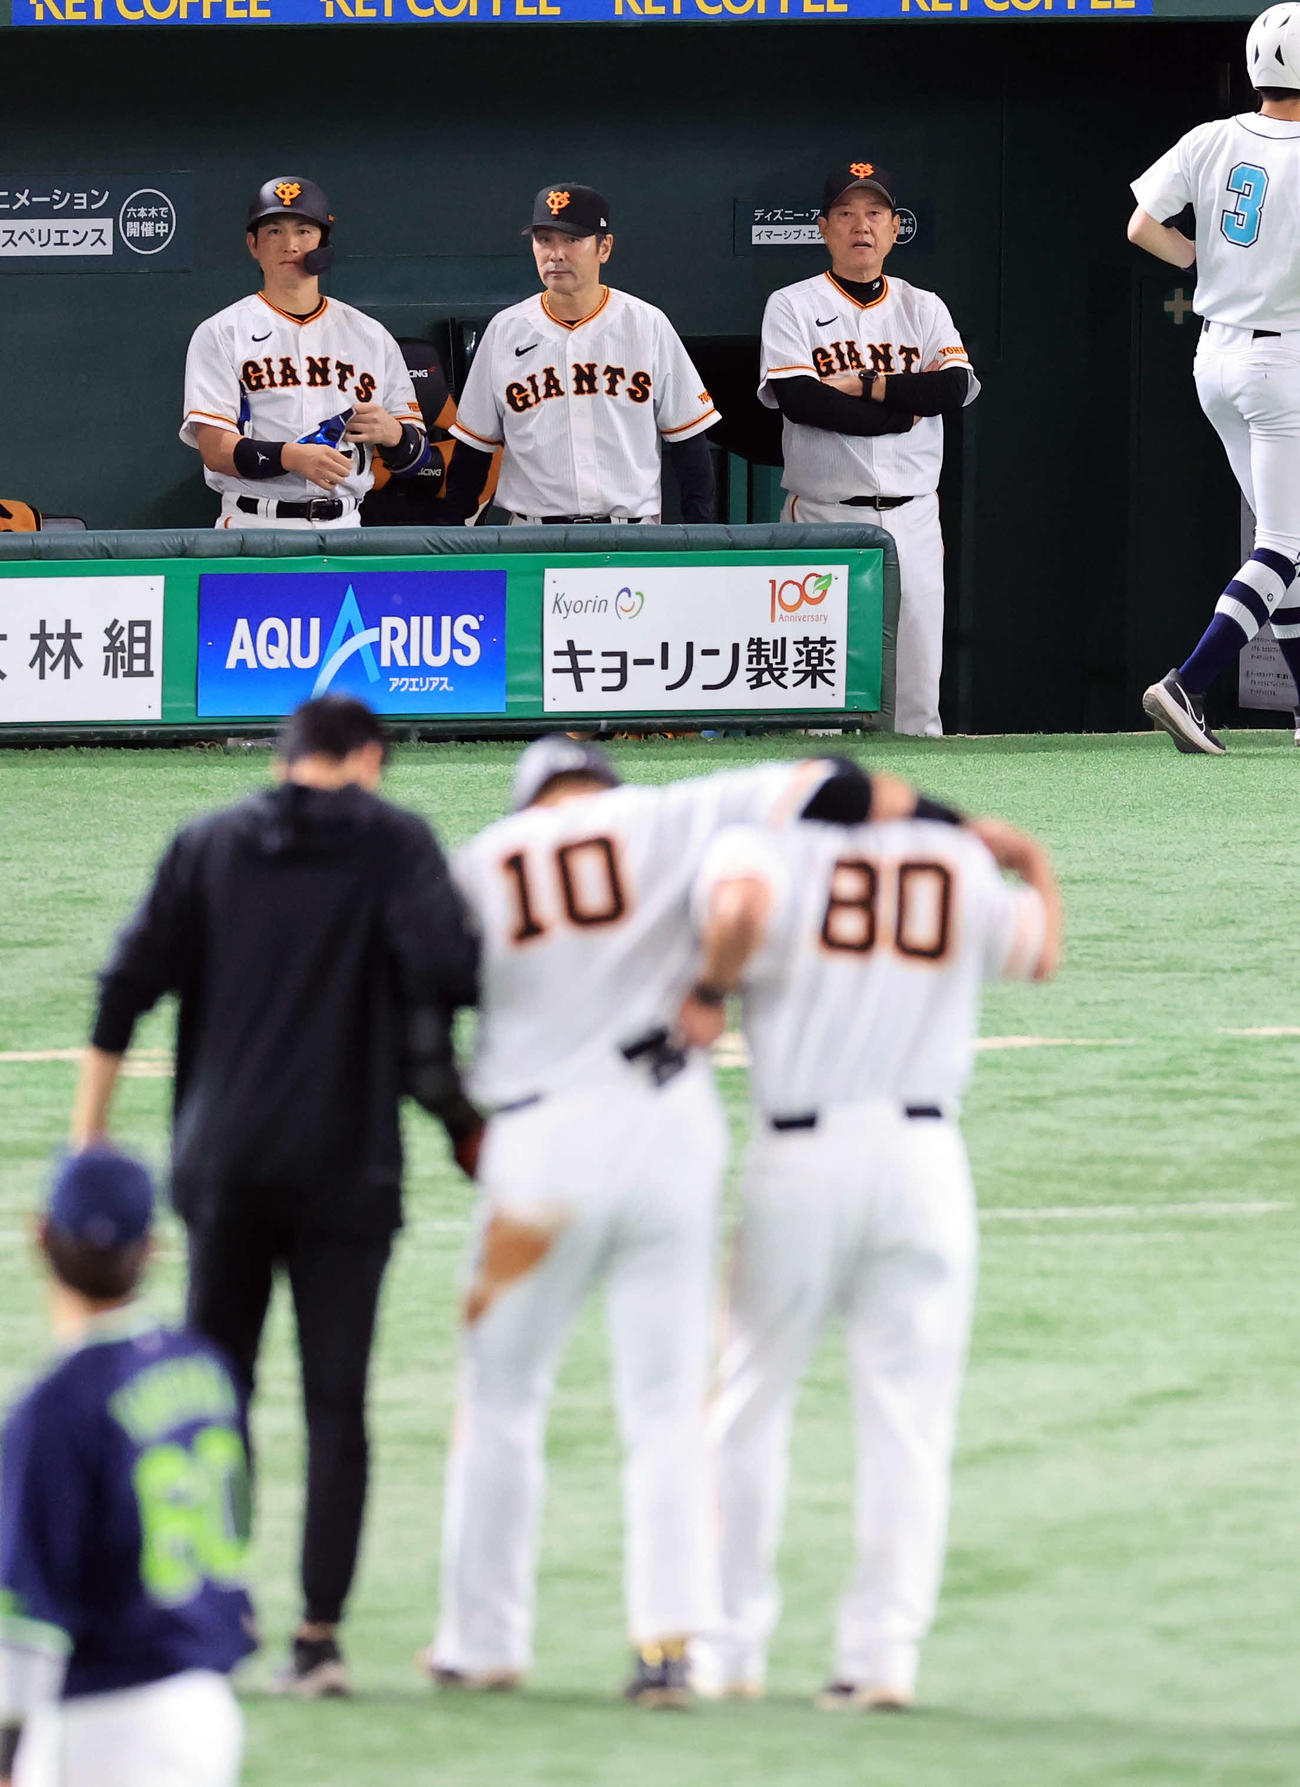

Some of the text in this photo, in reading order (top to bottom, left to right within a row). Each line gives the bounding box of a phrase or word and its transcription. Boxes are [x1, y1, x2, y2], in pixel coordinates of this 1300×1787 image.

[126, 207, 169, 219] 六本木で
[126, 221, 169, 238] 開催中
[1220, 161, 1269, 248] 3
[242, 356, 377, 402] GIANTS
[811, 340, 921, 377] GIANT
[505, 362, 652, 413] GIANTS
[552, 592, 608, 620] Kyorin
[769, 572, 832, 623] 100
[778, 613, 828, 624] Anniversary
[0, 618, 154, 680] 林組
[225, 584, 482, 684] AQUARIUS
[389, 677, 451, 692] アクエリアス
[552, 636, 837, 692] キョーリン製薬
[502, 836, 628, 945] 10
[820, 860, 957, 960] 80
